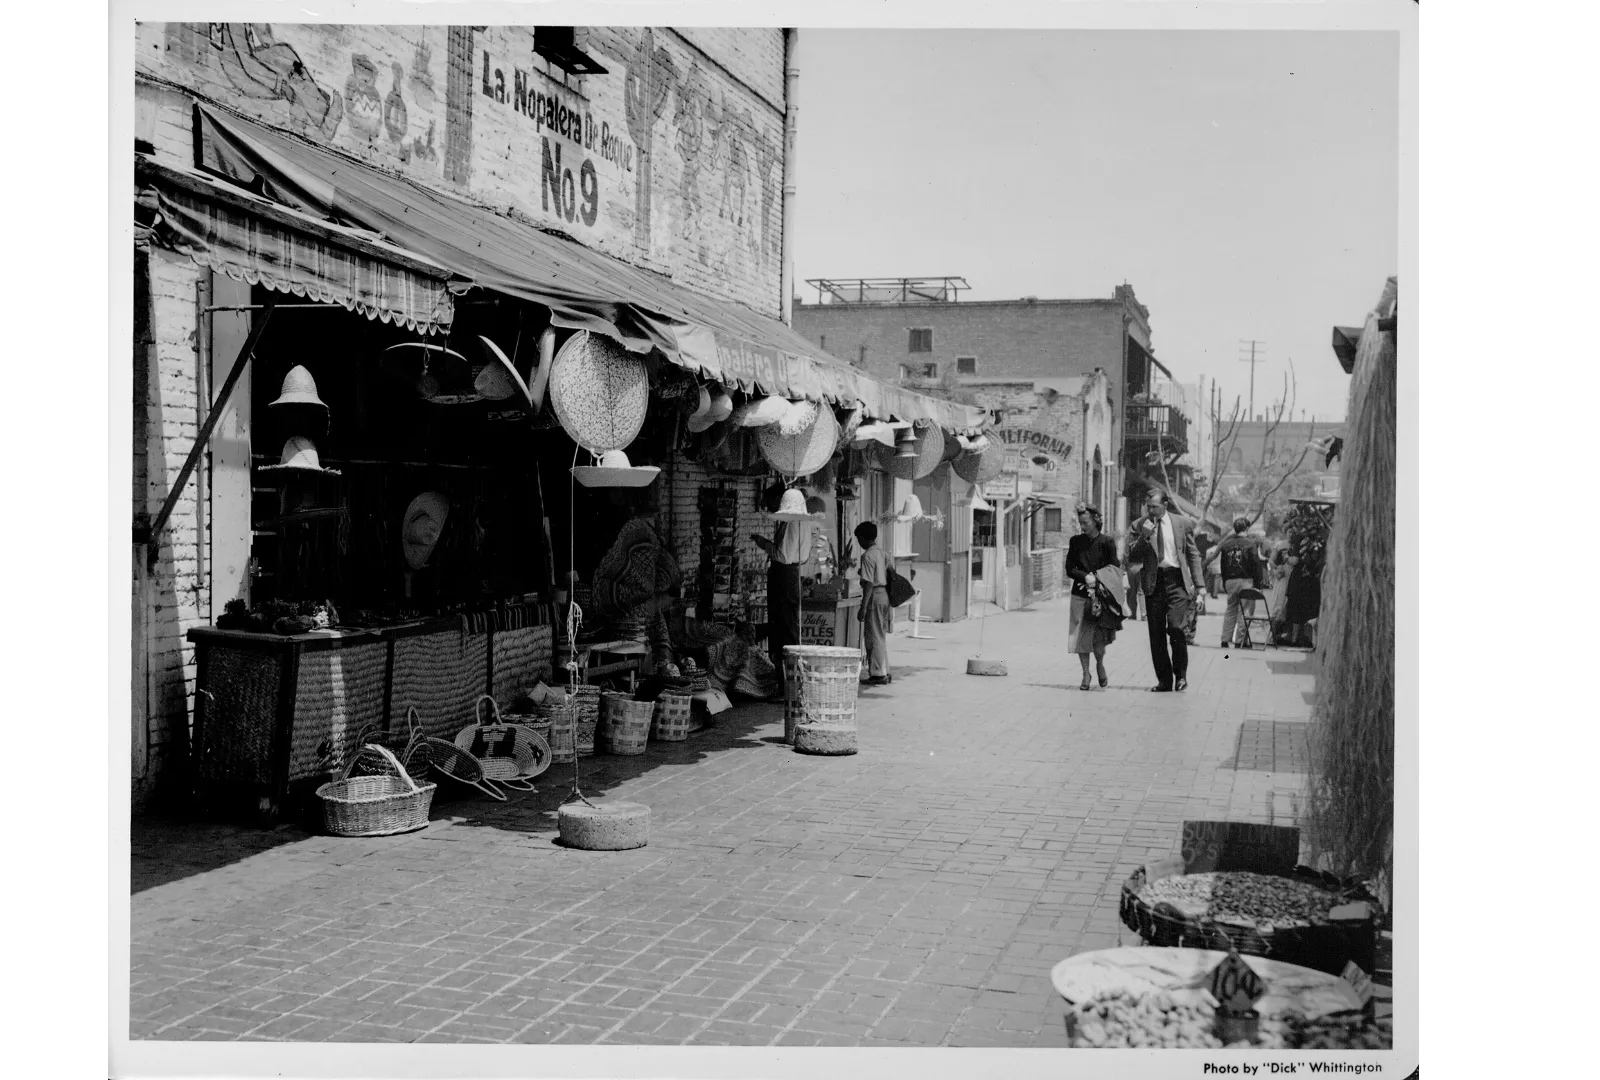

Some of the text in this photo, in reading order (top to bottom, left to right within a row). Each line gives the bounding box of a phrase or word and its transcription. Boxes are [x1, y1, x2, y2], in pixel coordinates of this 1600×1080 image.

[514, 66, 582, 145] Nopalera
[585, 111, 599, 154] De
[999, 428, 1072, 460] ALIFORNIA
[803, 614, 828, 627] Baby
